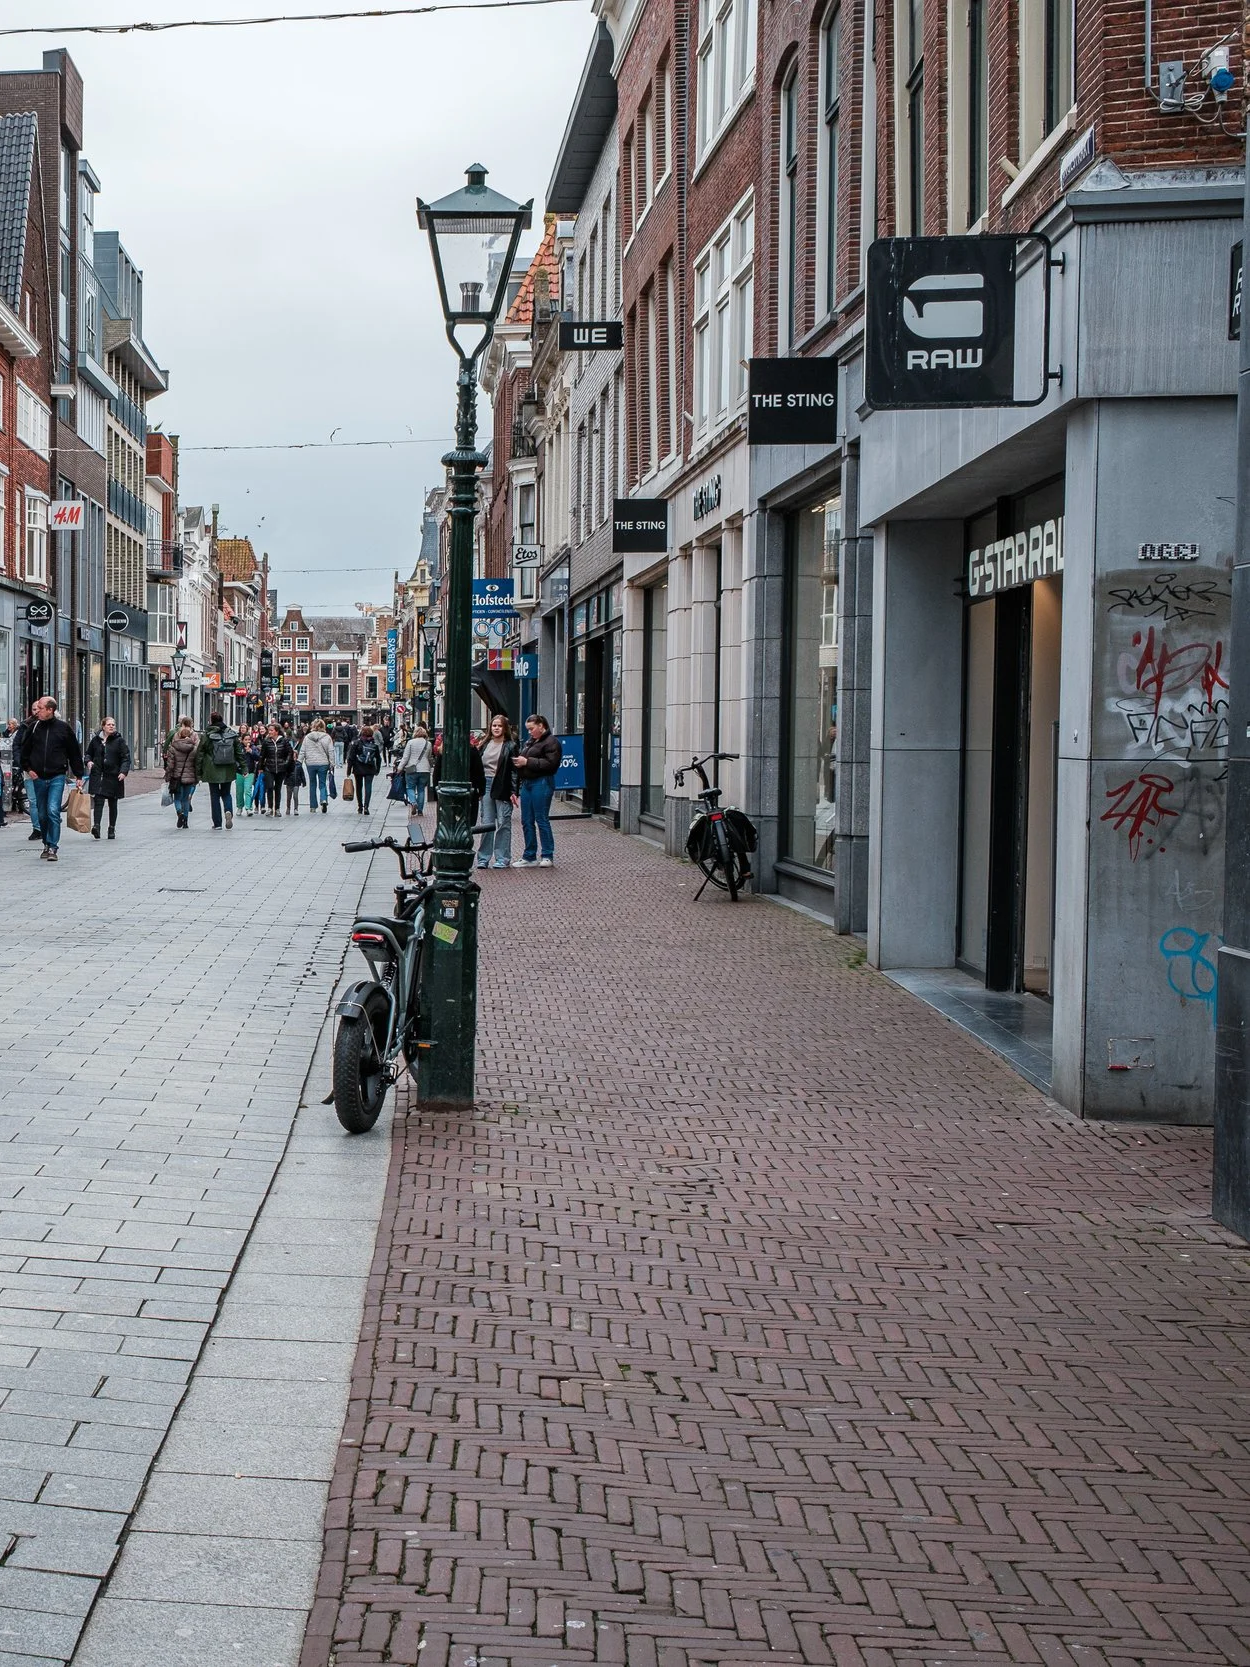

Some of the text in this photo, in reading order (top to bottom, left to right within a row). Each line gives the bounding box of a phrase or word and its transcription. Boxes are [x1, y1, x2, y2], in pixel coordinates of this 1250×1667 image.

[573, 327, 607, 344] WE
[906, 348, 983, 370] RAW
[752, 393, 835, 408] THE STING
[54, 505, 82, 526] H&M
[614, 520, 666, 530] THE STING
[514, 547, 538, 562] Etos
[968, 530, 1028, 597] G-STAR
